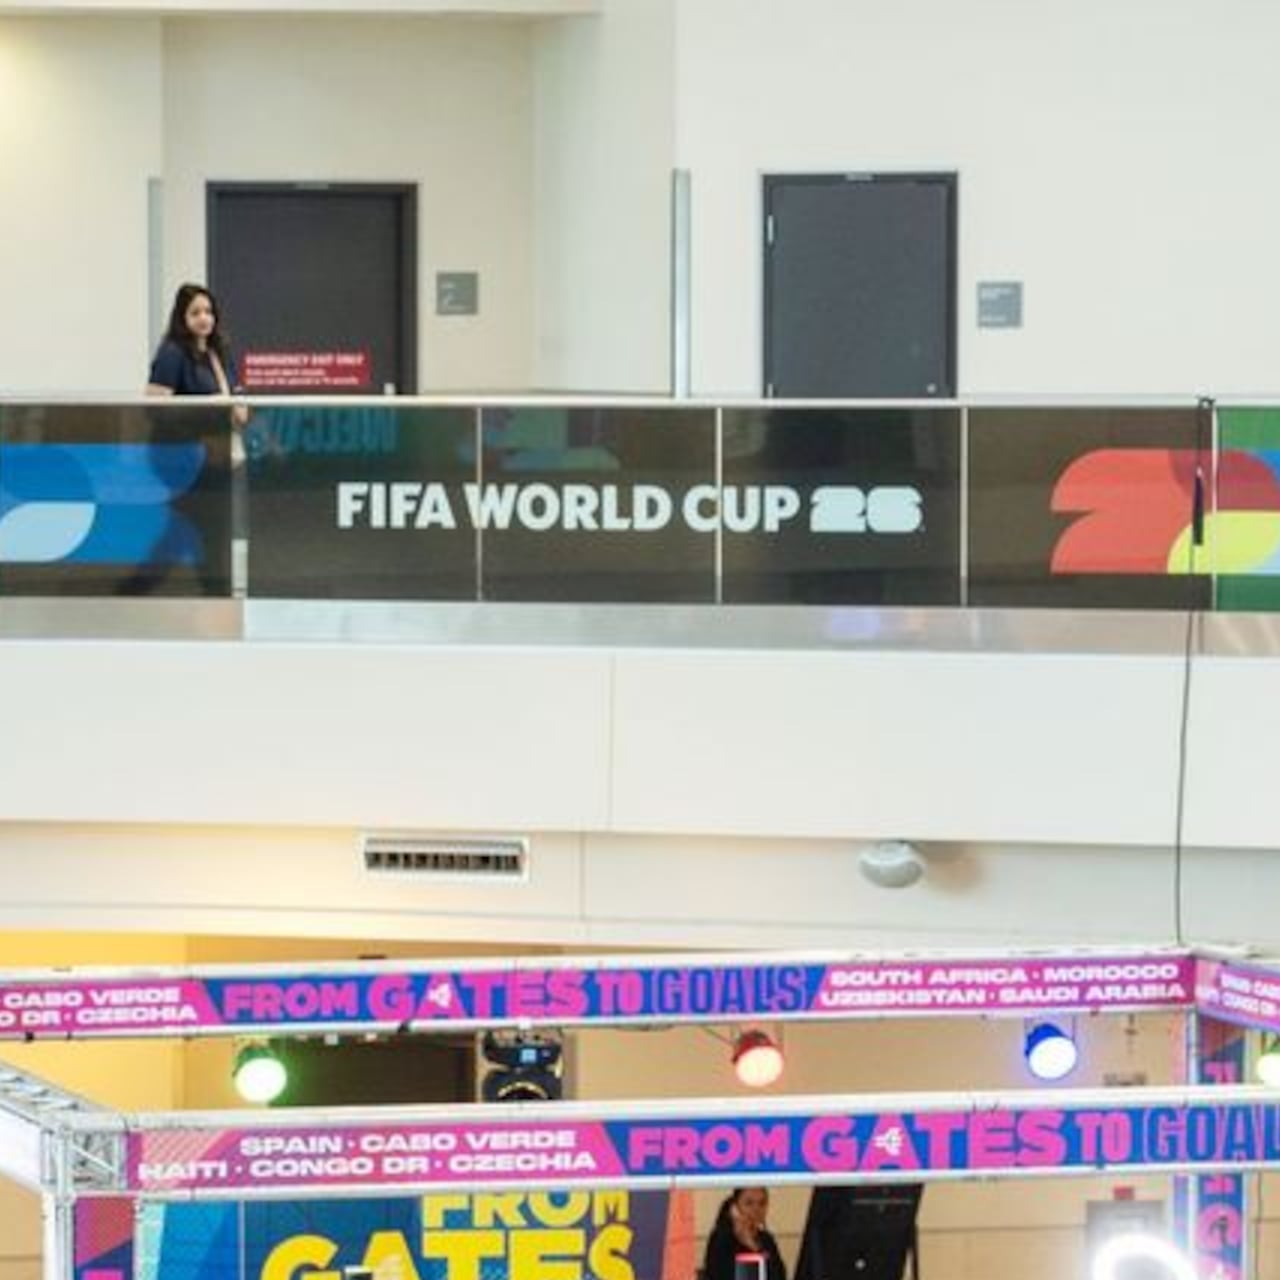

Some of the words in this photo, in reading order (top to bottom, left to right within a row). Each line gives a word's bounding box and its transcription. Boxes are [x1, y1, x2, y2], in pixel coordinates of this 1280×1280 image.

[337, 482, 456, 529] FIFA
[467, 483, 671, 531] WORLD
[682, 484, 801, 532] CUP
[809, 486, 925, 534] 26
[831, 969, 919, 987] SOUTH
[928, 967, 1028, 985] AFRICA
[1045, 965, 1179, 983] MOROCCO
[4, 990, 83, 1009] CABO
[90, 986, 181, 1005] VERDE
[222, 982, 358, 1021] FROM
[366, 968, 587, 1022] GATES
[595, 968, 642, 1017] TO
[650, 965, 809, 1014] GOALS
[822, 988, 986, 1007] UZBEKISTAN
[1004, 987, 1079, 1004] SAUDI
[1085, 984, 1186, 1002] ARABIA
[22, 1008, 61, 1027] DR
[76, 1004, 197, 1025] CZECHIA
[240, 1136, 341, 1157] SPAIN
[361, 1133, 456, 1153] CABO
[464, 1130, 577, 1150] VERDE
[629, 1128, 789, 1171] FROM
[801, 1109, 1070, 1173] GATES
[1075, 1112, 1131, 1163] TO
[138, 1161, 228, 1182] HAITI
[250, 1157, 375, 1179] CONGO
[382, 1155, 429, 1176] DR
[450, 1152, 597, 1173] CZECHIA
